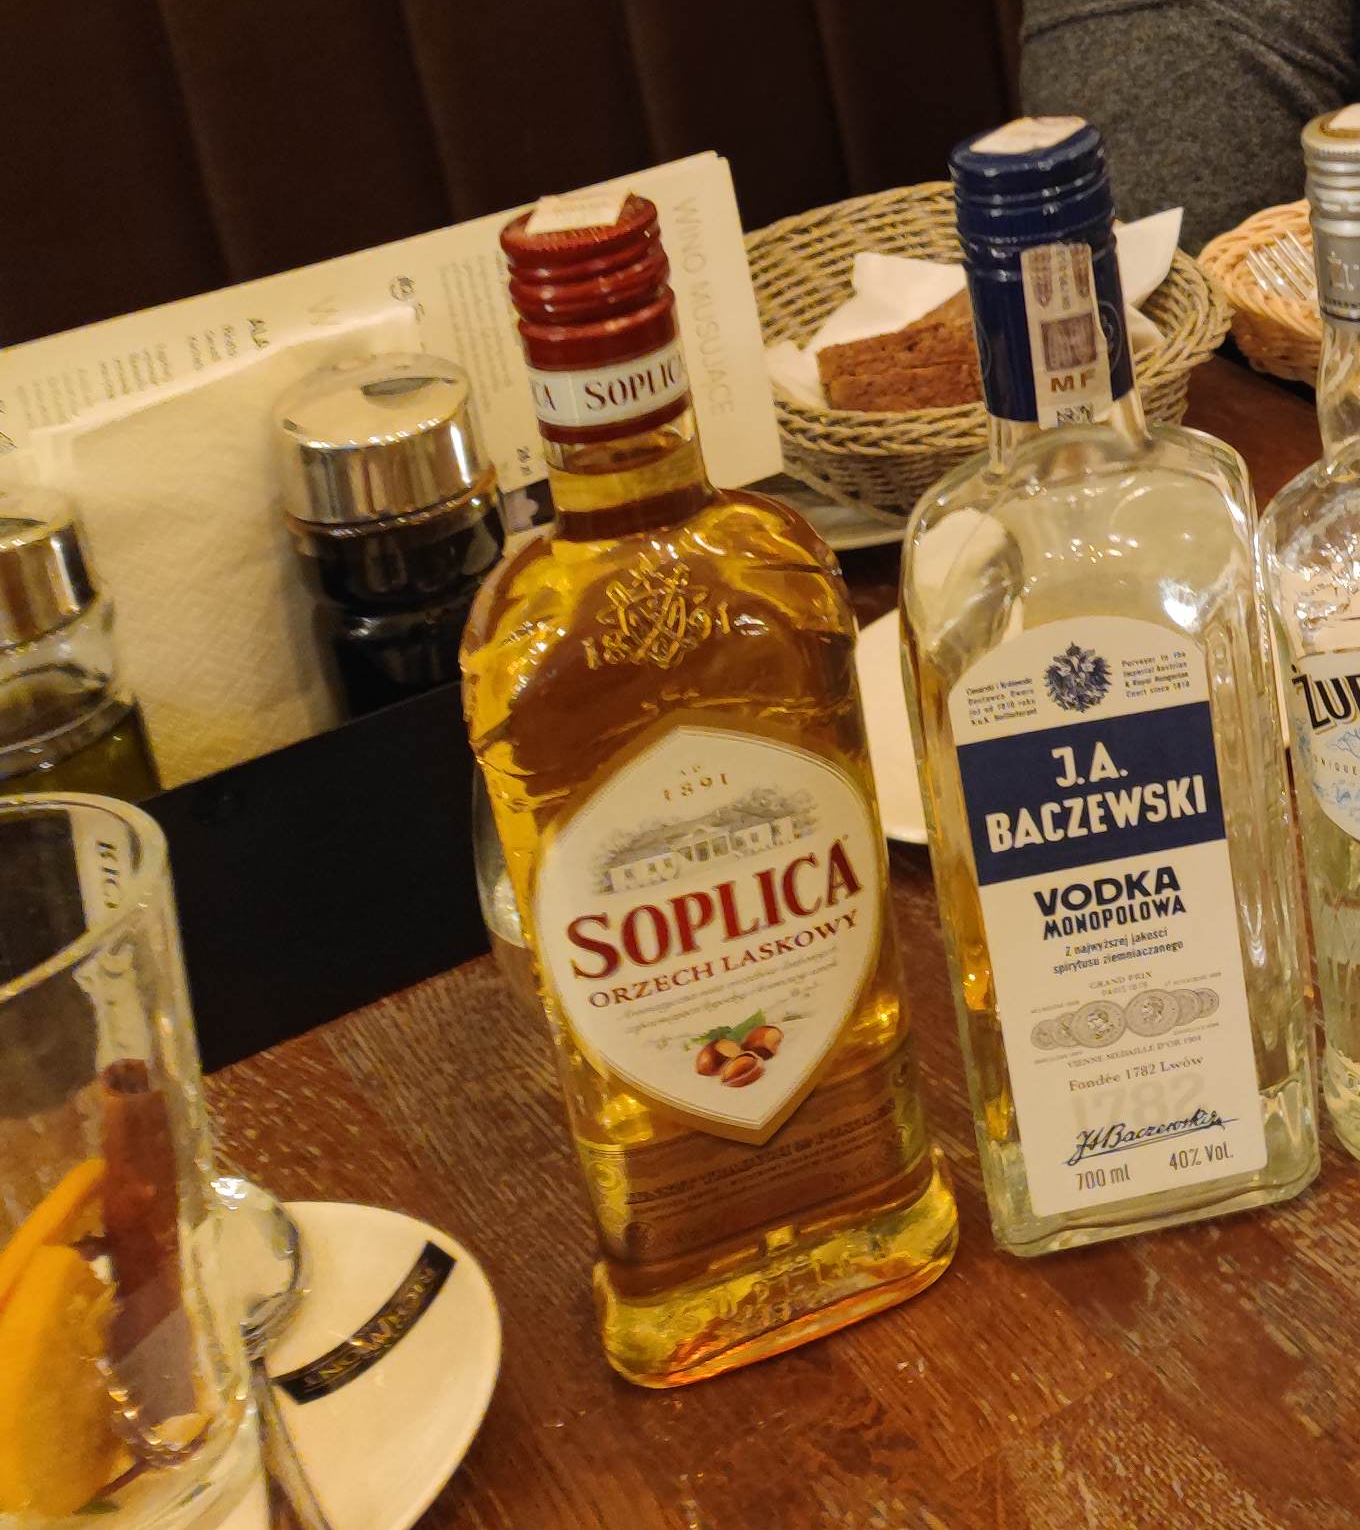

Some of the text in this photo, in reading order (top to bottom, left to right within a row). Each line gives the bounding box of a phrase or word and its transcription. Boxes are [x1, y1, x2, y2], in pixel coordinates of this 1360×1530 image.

[671, 194, 708, 273] WINO
[584, 354, 682, 410] SOPLIC
[1051, 741, 1129, 789] J.A.
[985, 774, 1209, 855] BACZEWSKI
[566, 836, 862, 980] SOPLICA
[1033, 866, 1181, 917] VODKA
[1043, 895, 1187, 940] MONOPOLOWA
[588, 960, 715, 1008] ORZECH
[721, 908, 859, 972] LASKOWY
[1068, 1055, 1205, 1092] Fondée 1782 Lwów
[1075, 1162, 1132, 1191] 700 ml
[1169, 1141, 1234, 1171] 40% Vol.
